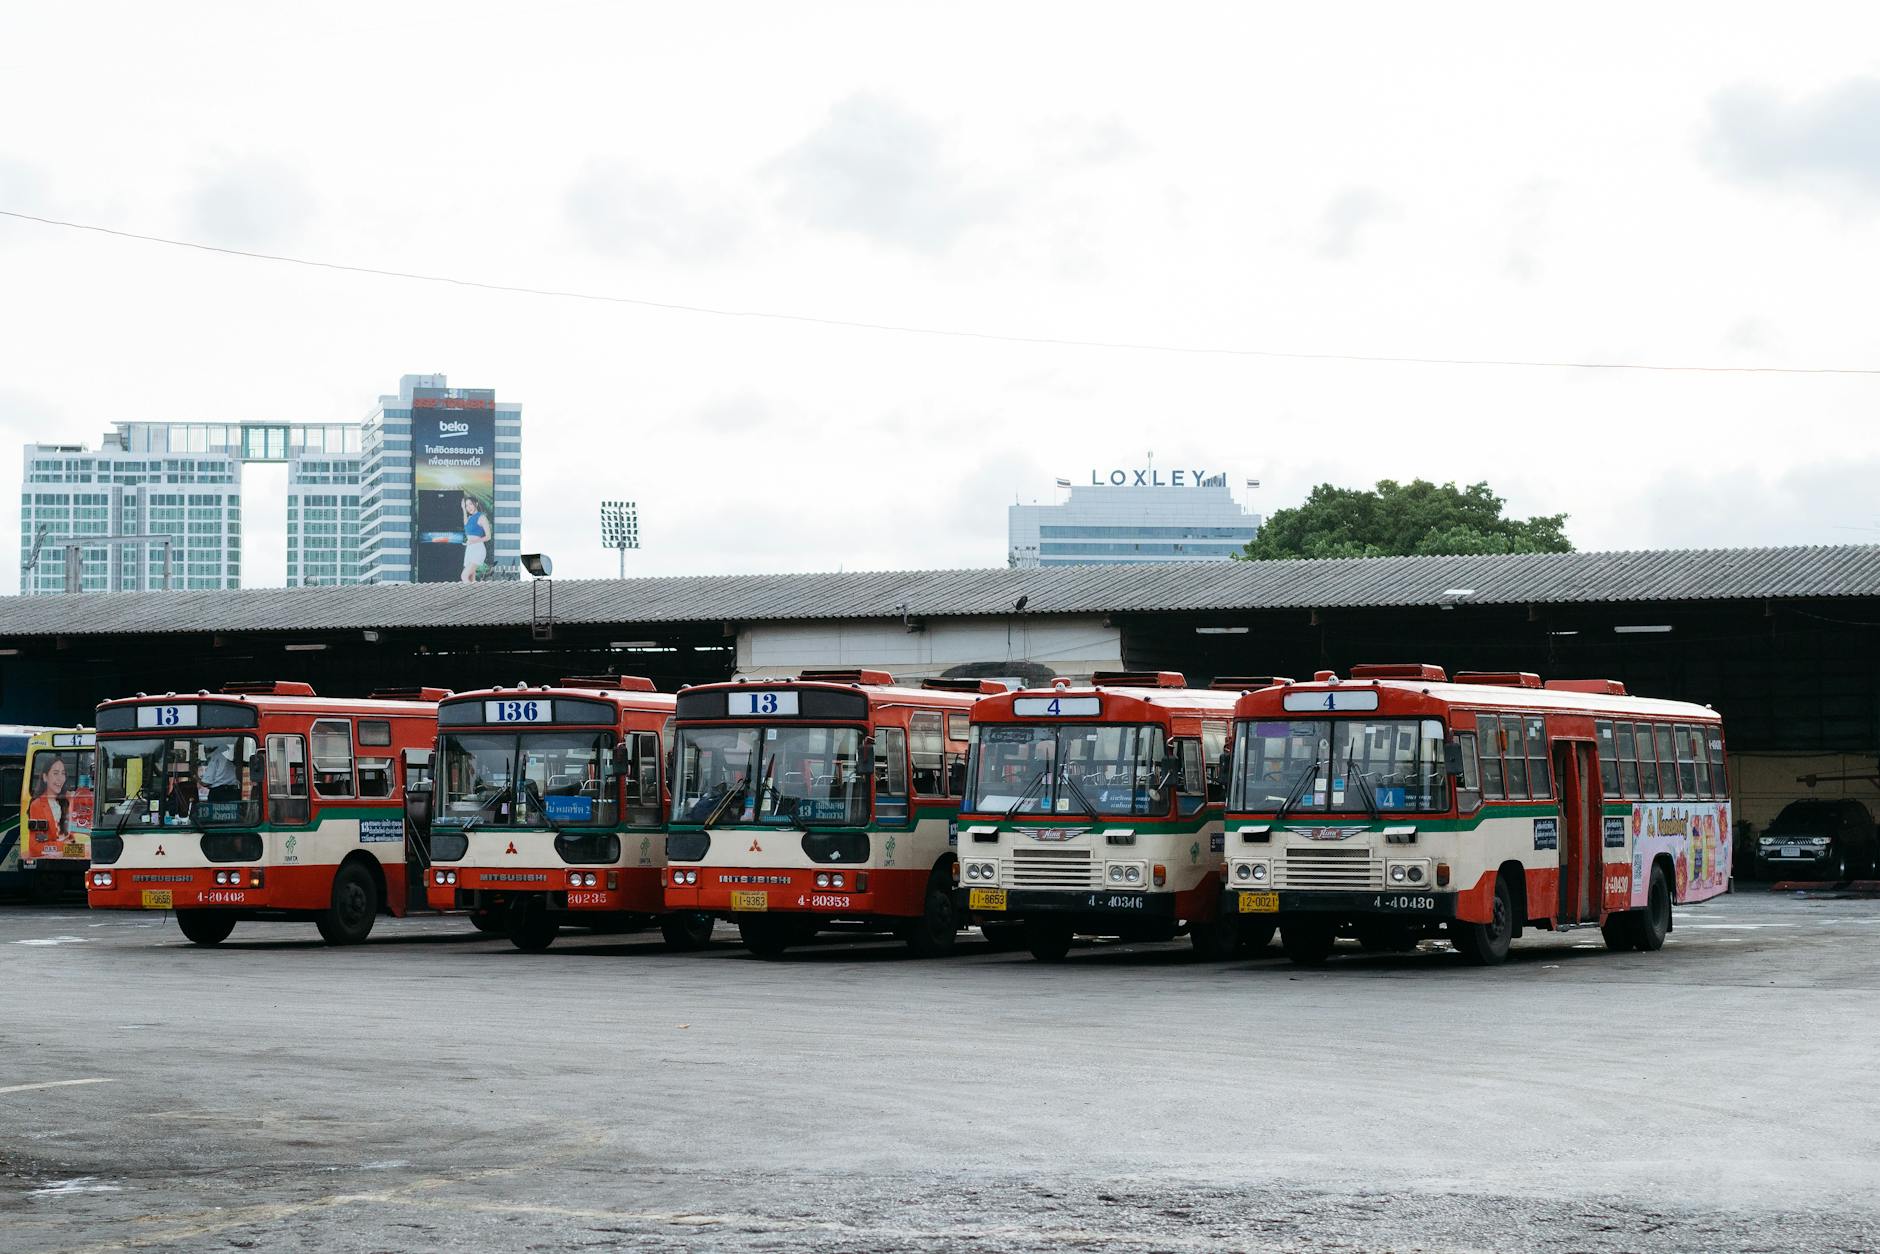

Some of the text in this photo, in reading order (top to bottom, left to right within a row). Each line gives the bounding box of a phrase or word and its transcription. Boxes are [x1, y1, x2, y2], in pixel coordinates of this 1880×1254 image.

[440, 421, 469, 432] beko
[1092, 469, 1205, 487] LOXLEY
[748, 694, 778, 713] 13
[1047, 698, 1060, 715] 4
[1323, 693, 1336, 709] 4
[155, 707, 179, 726] 13
[496, 701, 538, 721] 136
[70, 735, 82, 746] 47
[798, 805, 812, 817] 13
[132, 875, 193, 883] MITSUBISHI
[480, 874, 547, 882] MITSUBISHI
[719, 875, 791, 884] MITSUBISHI
[567, 893, 607, 904] 80235
[797, 894, 850, 907] 4-80353
